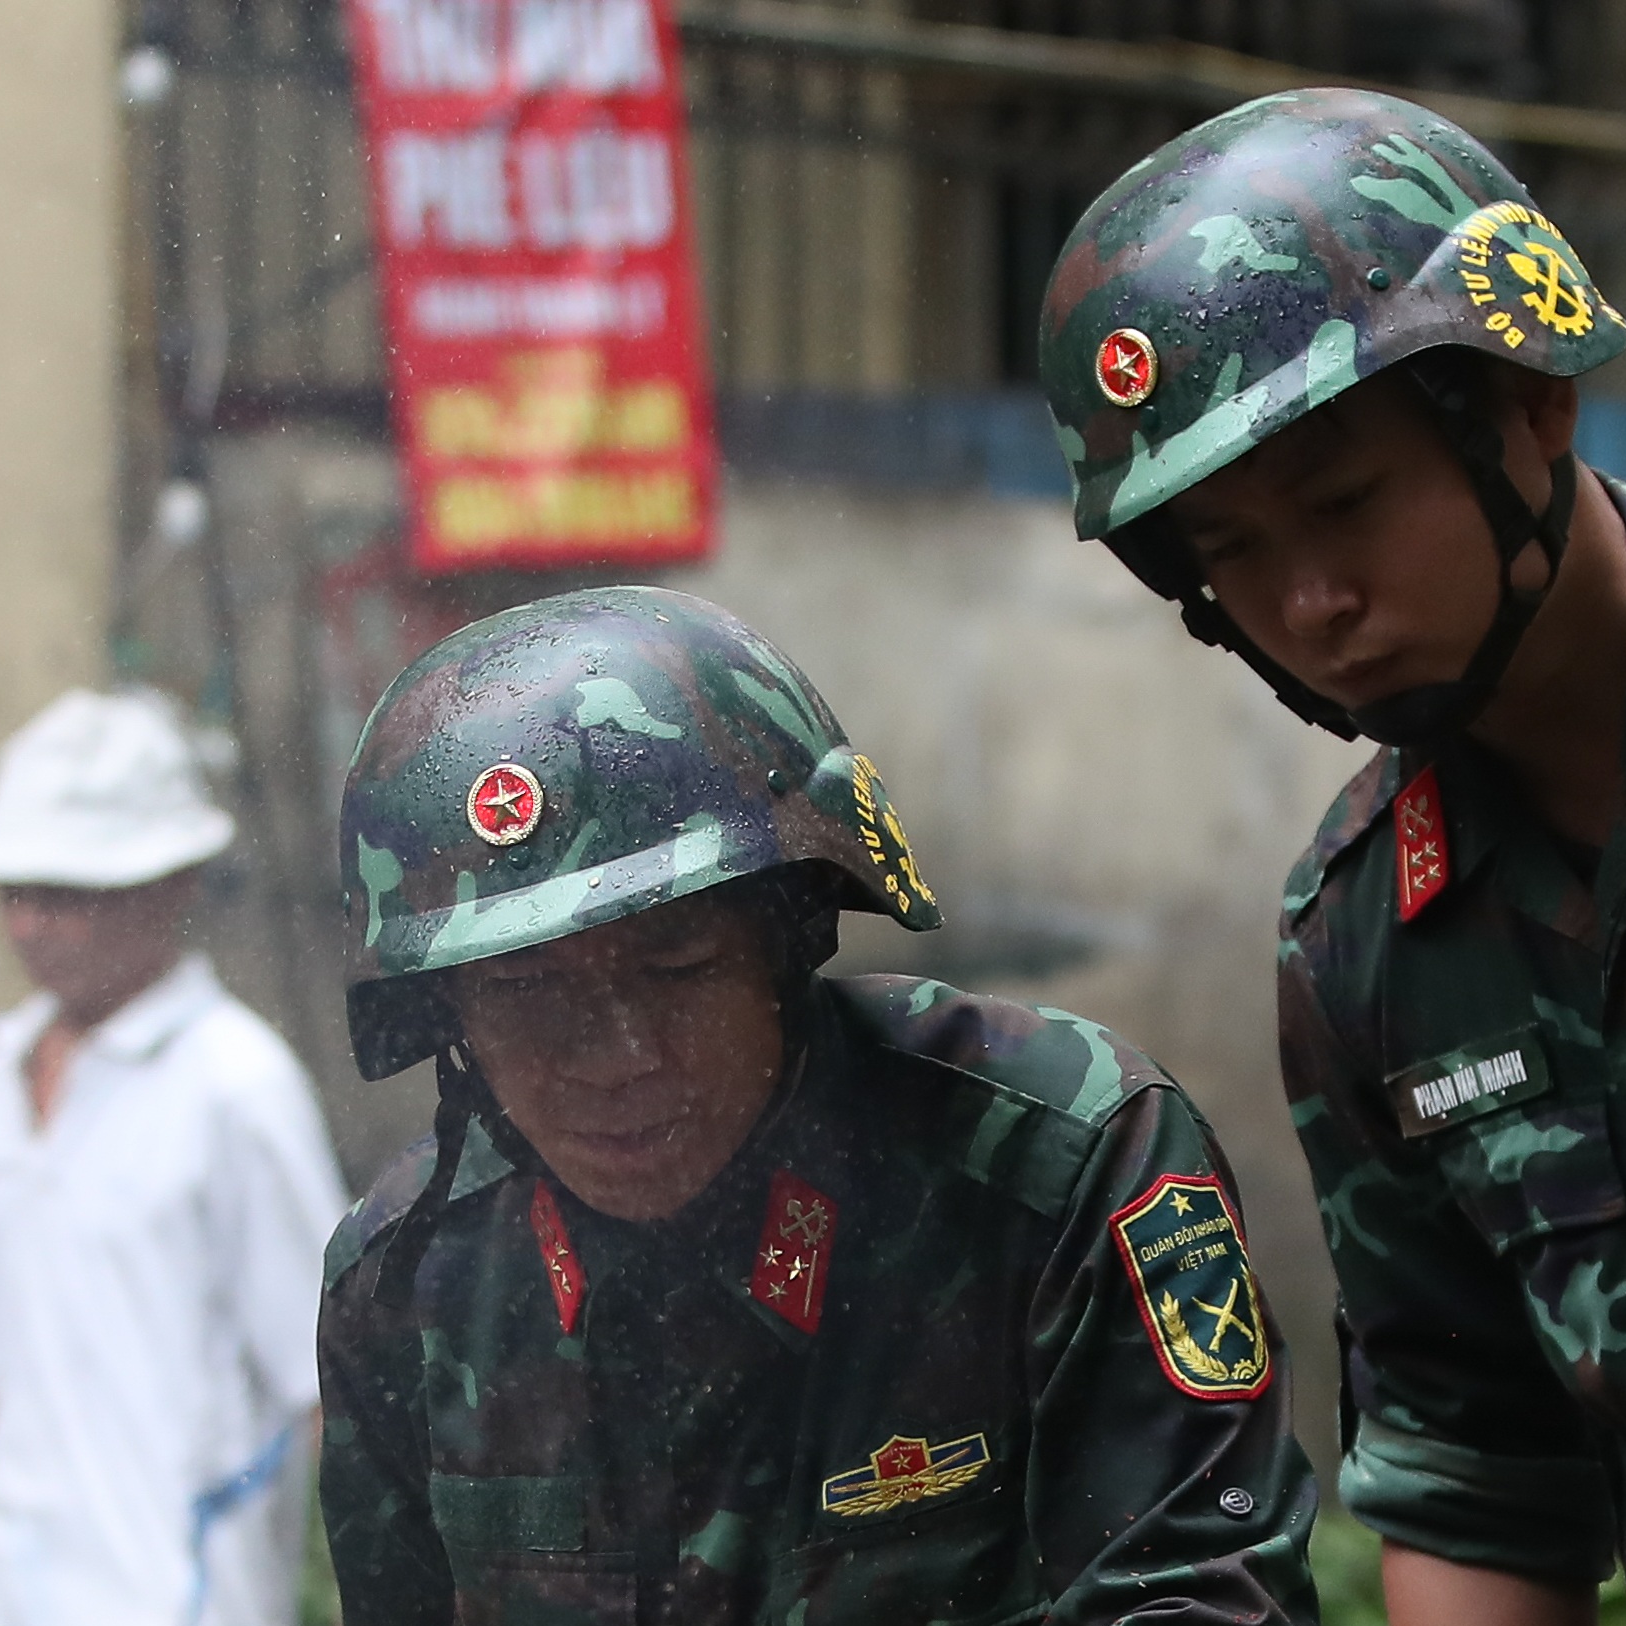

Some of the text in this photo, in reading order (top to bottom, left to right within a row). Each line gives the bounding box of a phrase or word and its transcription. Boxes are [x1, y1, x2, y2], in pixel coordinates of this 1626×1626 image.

[1459, 269, 1497, 306] TƯ
[1485, 311, 1526, 349] BỘ
[1413, 1075, 1458, 1119] PHẠM
[1477, 1049, 1527, 1096] MẠNH
[1140, 1236, 1176, 1263] QUÂN
[1174, 1225, 1196, 1246] ĐỘI
[1176, 1242, 1229, 1272] VIỆT NAM
